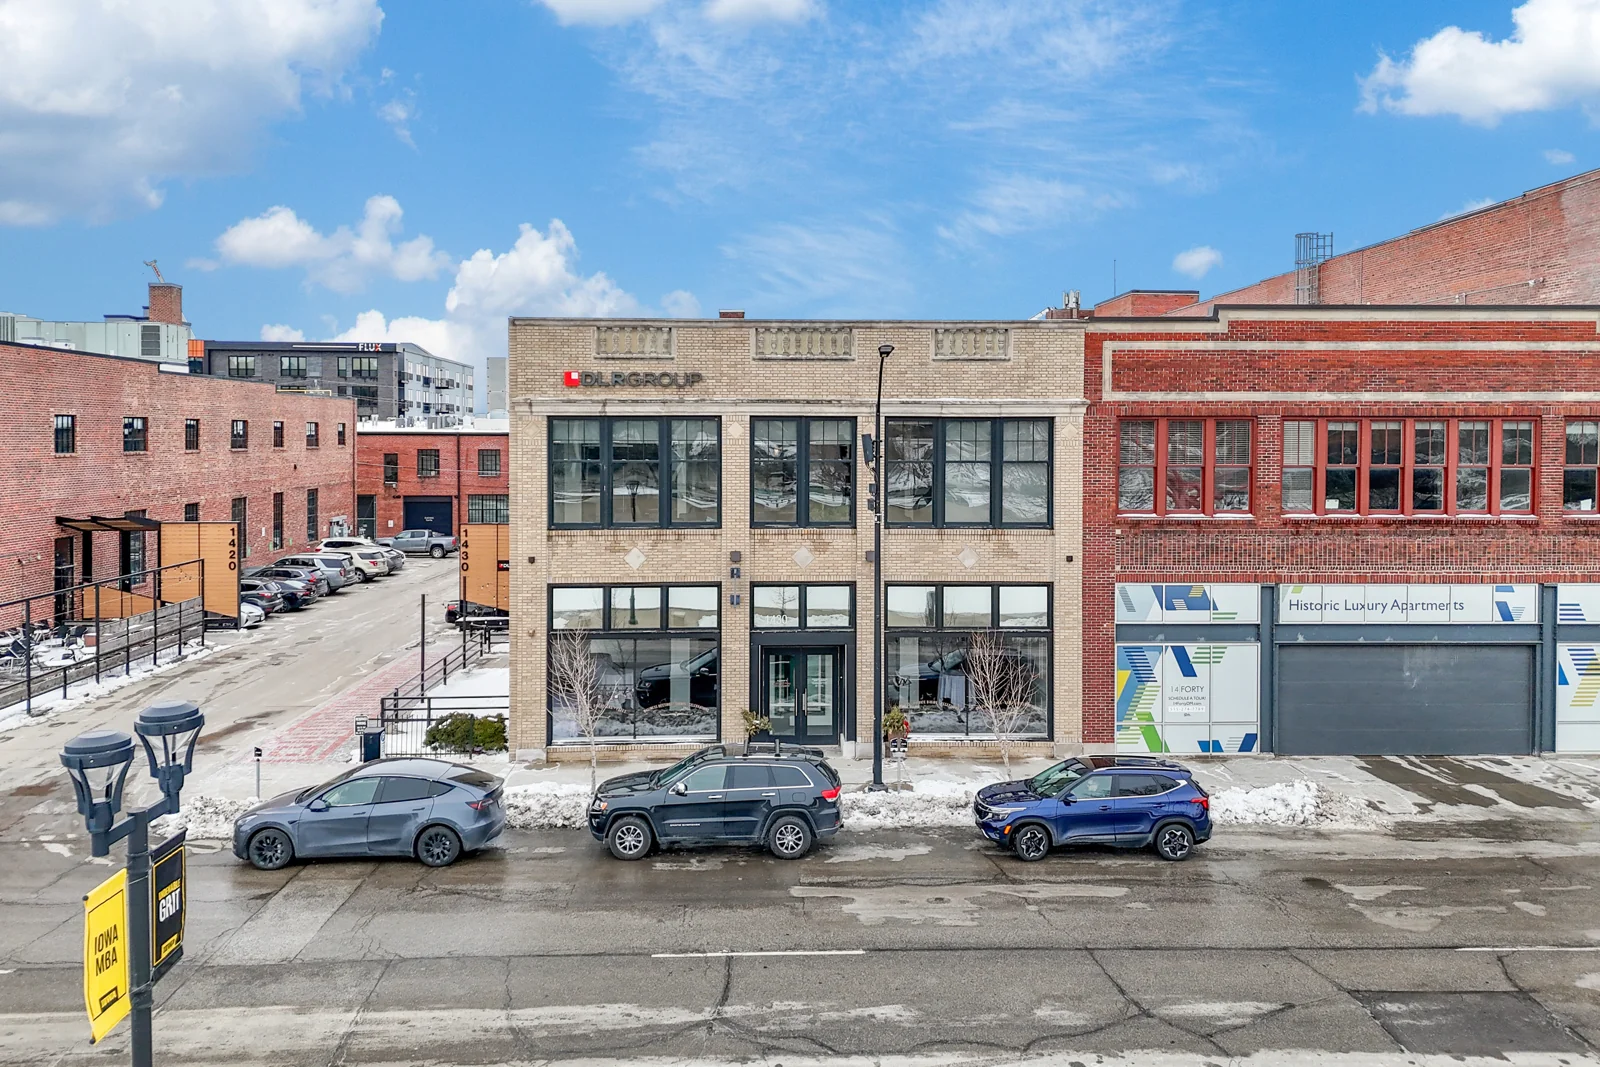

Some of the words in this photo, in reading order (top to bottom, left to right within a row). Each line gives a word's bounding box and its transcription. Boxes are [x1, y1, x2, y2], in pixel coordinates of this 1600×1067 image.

[358, 343, 382, 352] FLUX
[228, 527, 236, 571] 1420
[461, 528, 469, 572] 1430
[1289, 599, 1340, 611] Historic
[1344, 599, 1388, 614] Luxury
[1180, 685, 1205, 693] FORTY
[159, 887, 181, 922] GRIT
[94, 923, 119, 955] IOWA
[95, 946, 118, 977] MBA
